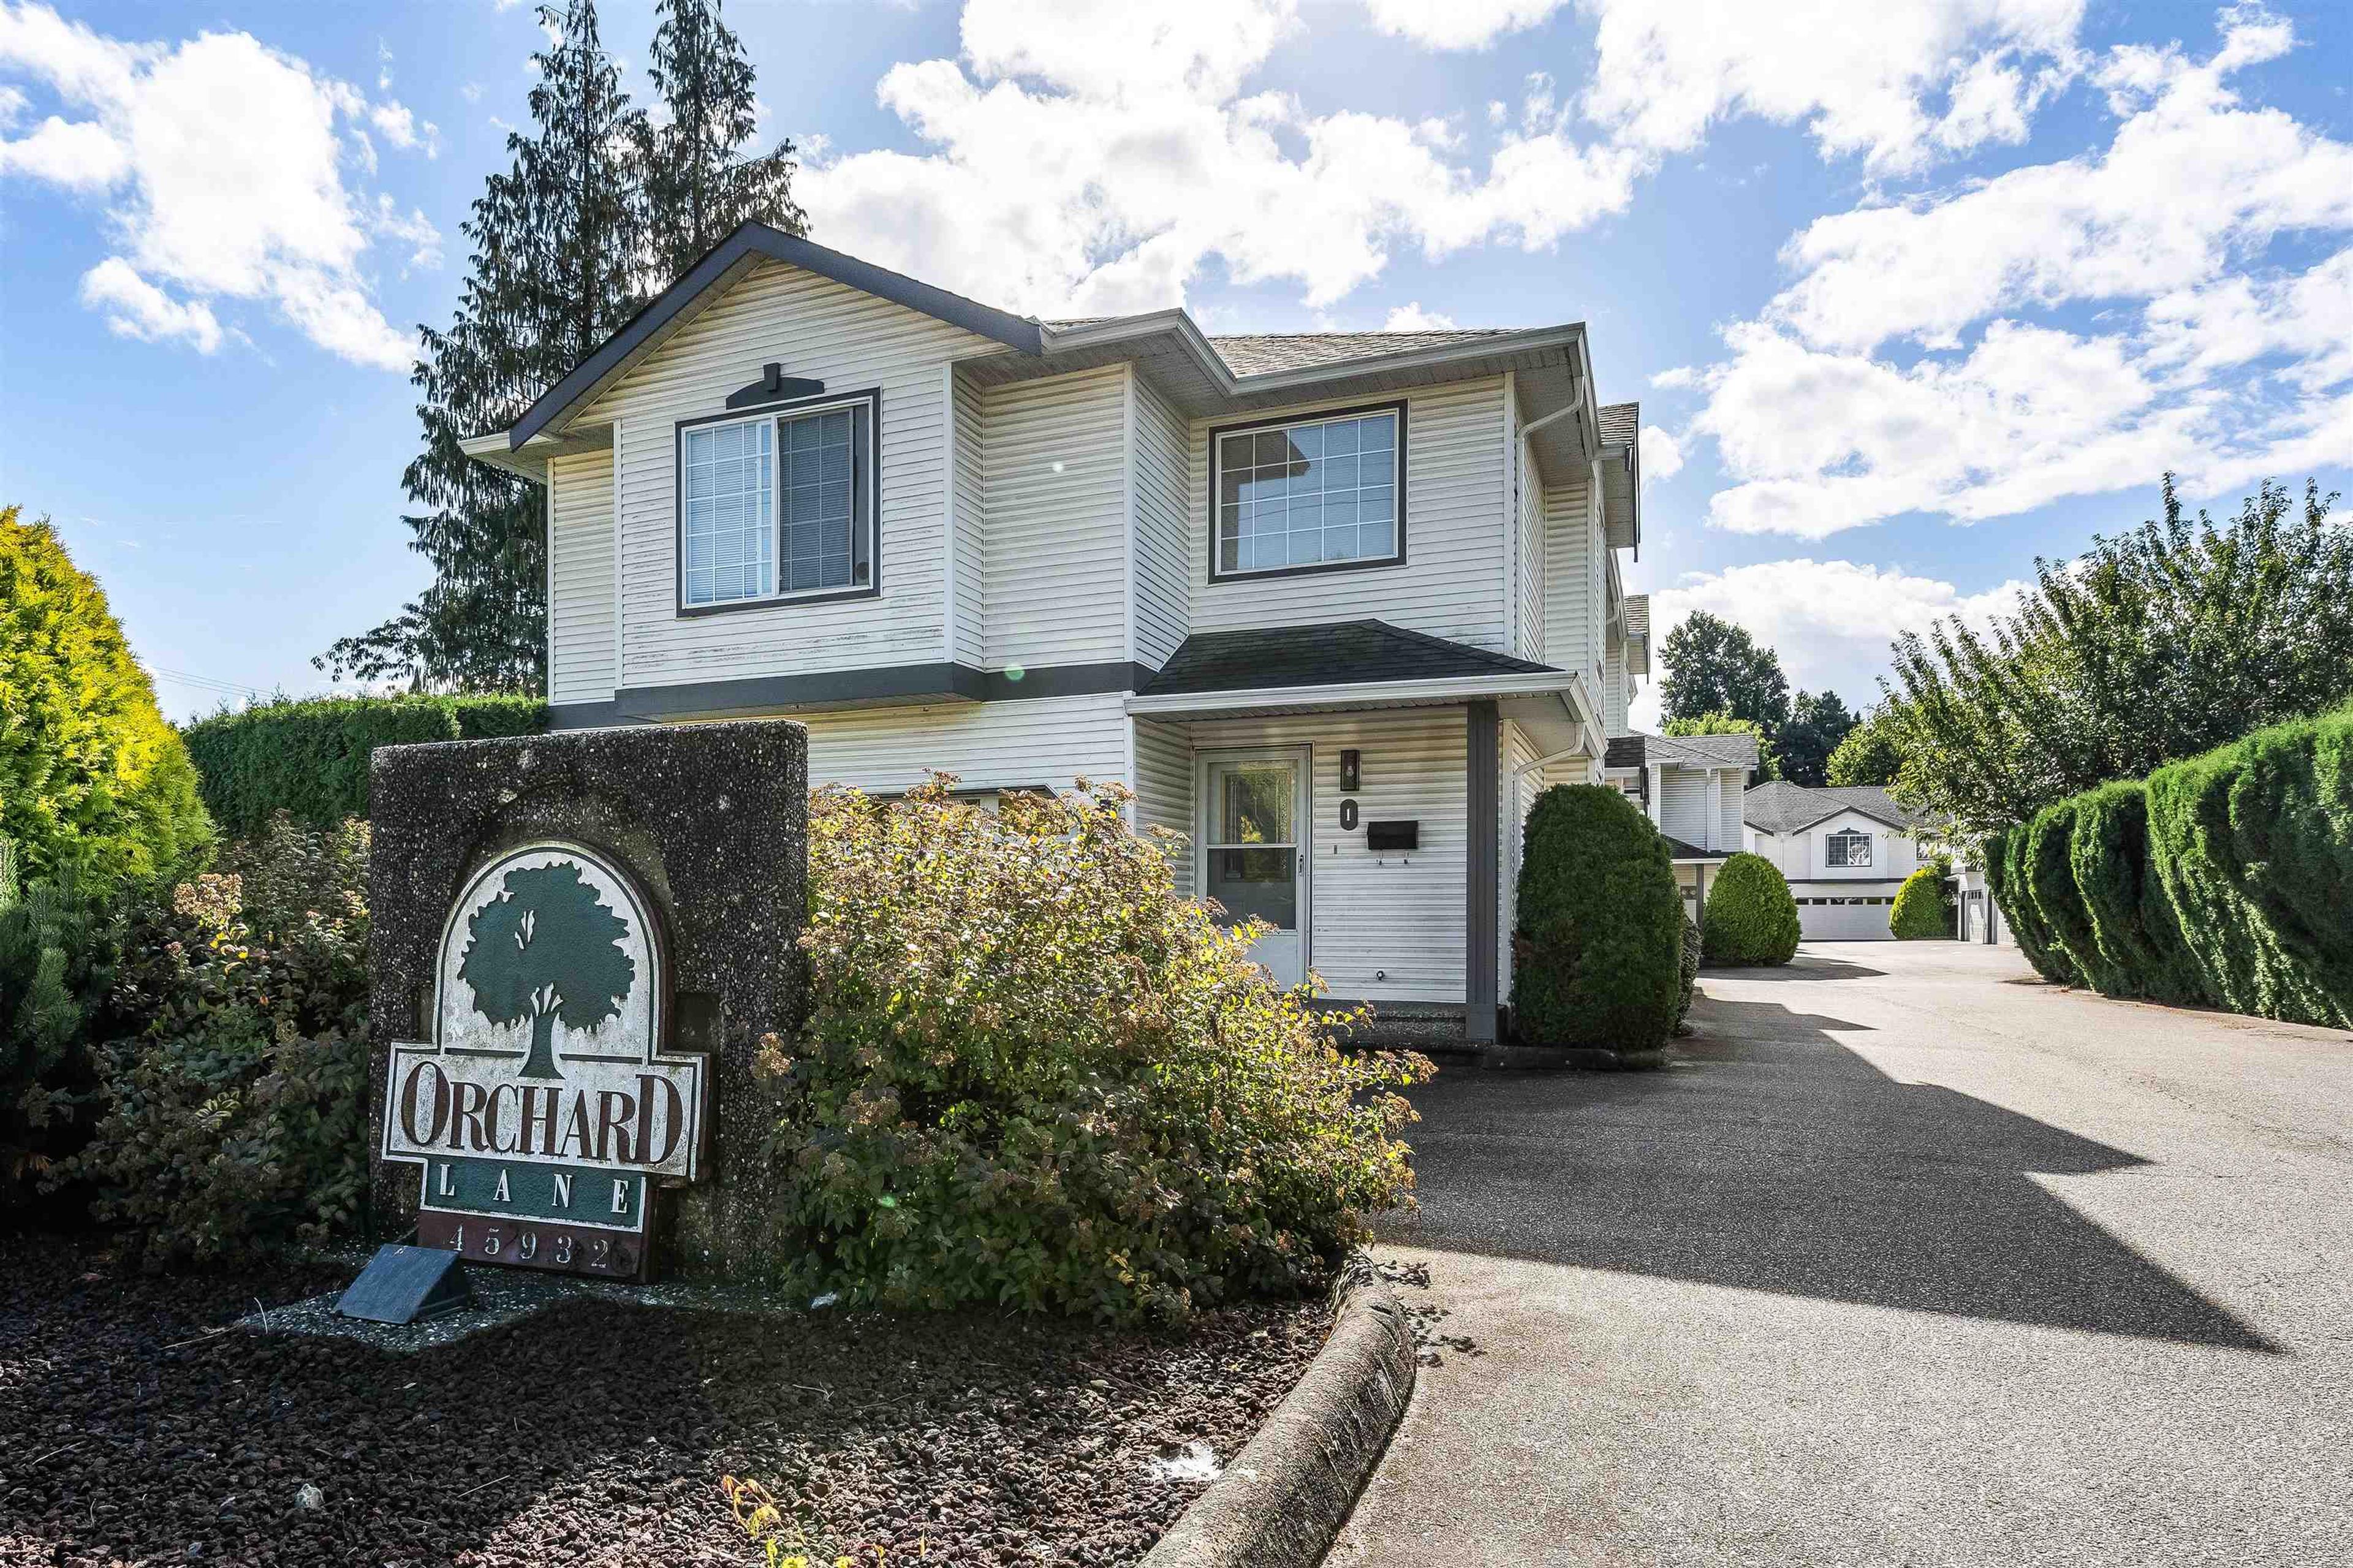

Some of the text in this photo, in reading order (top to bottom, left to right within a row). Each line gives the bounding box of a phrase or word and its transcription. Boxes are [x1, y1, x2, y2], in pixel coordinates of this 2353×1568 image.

[400, 1061, 683, 1164] ORCHARD
[439, 1164, 629, 1214] LANE
[447, 1224, 608, 1269] 45932
